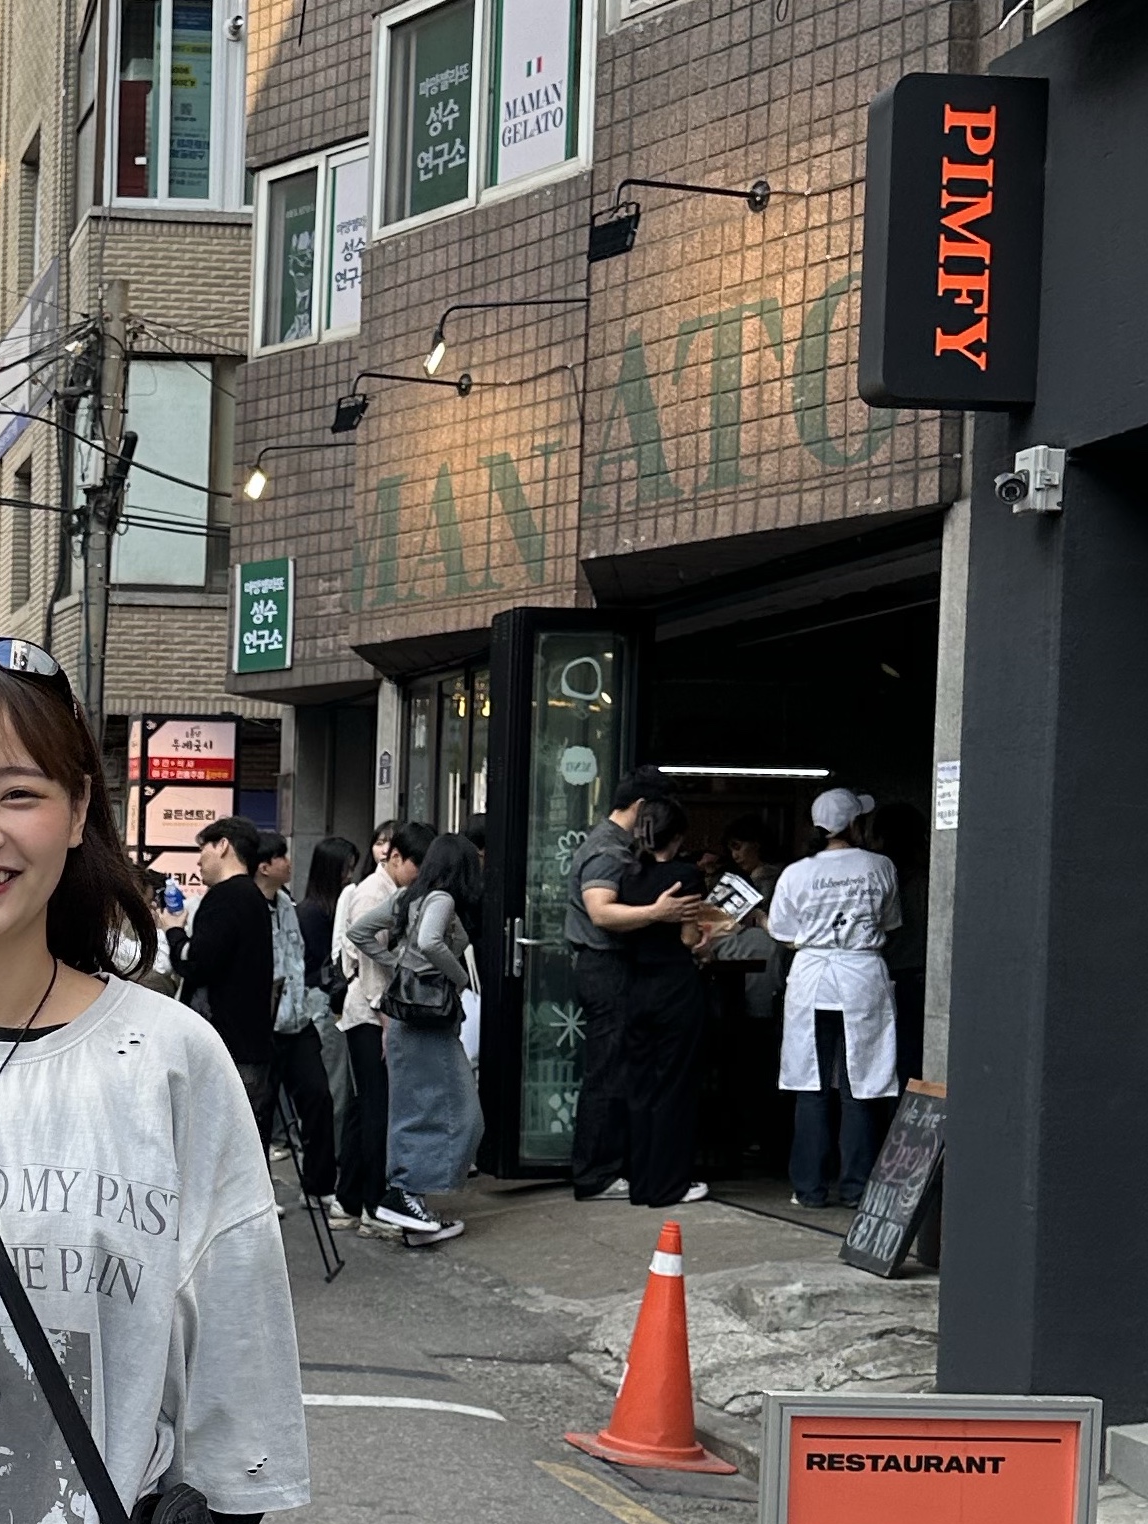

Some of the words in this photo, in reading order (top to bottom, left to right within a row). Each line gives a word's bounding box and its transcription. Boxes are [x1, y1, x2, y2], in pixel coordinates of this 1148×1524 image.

[425, 99, 460, 136] 성수
[504, 80, 563, 122] MAMAN
[502, 107, 563, 147] GELATO
[417, 138, 466, 181] 연구소
[935, 103, 997, 372] PIMFY
[335, 267, 362, 292] 연구
[250, 599, 278, 624] 성수
[243, 628, 283, 654] 연구소
[18, 1167, 80, 1213] MY
[806, 1453, 1005, 1474] RESTAURANT
